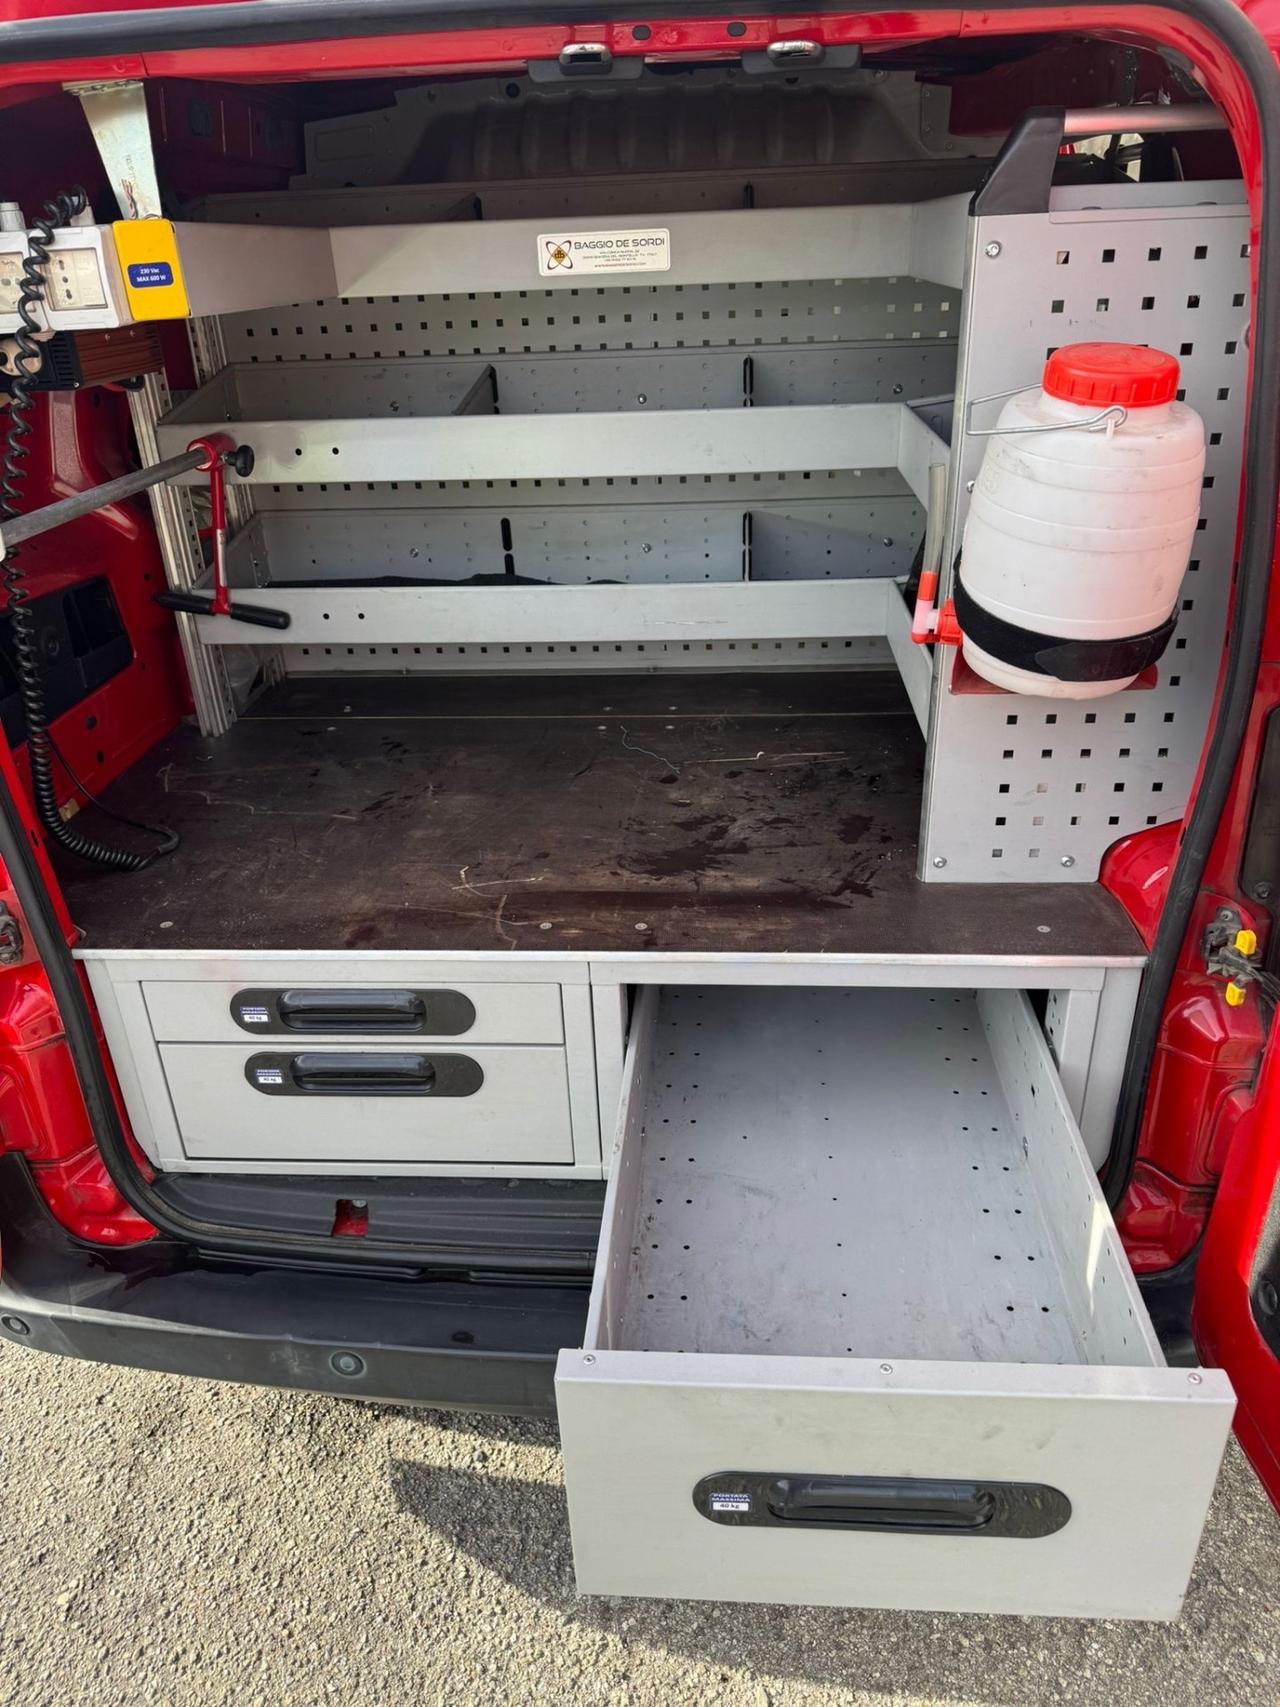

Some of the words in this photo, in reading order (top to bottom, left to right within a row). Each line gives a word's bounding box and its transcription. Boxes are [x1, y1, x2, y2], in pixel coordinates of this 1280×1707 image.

[574, 240, 613, 250] BAGGIO
[616, 239, 629, 248] DE
[631, 238, 665, 248] SORDI
